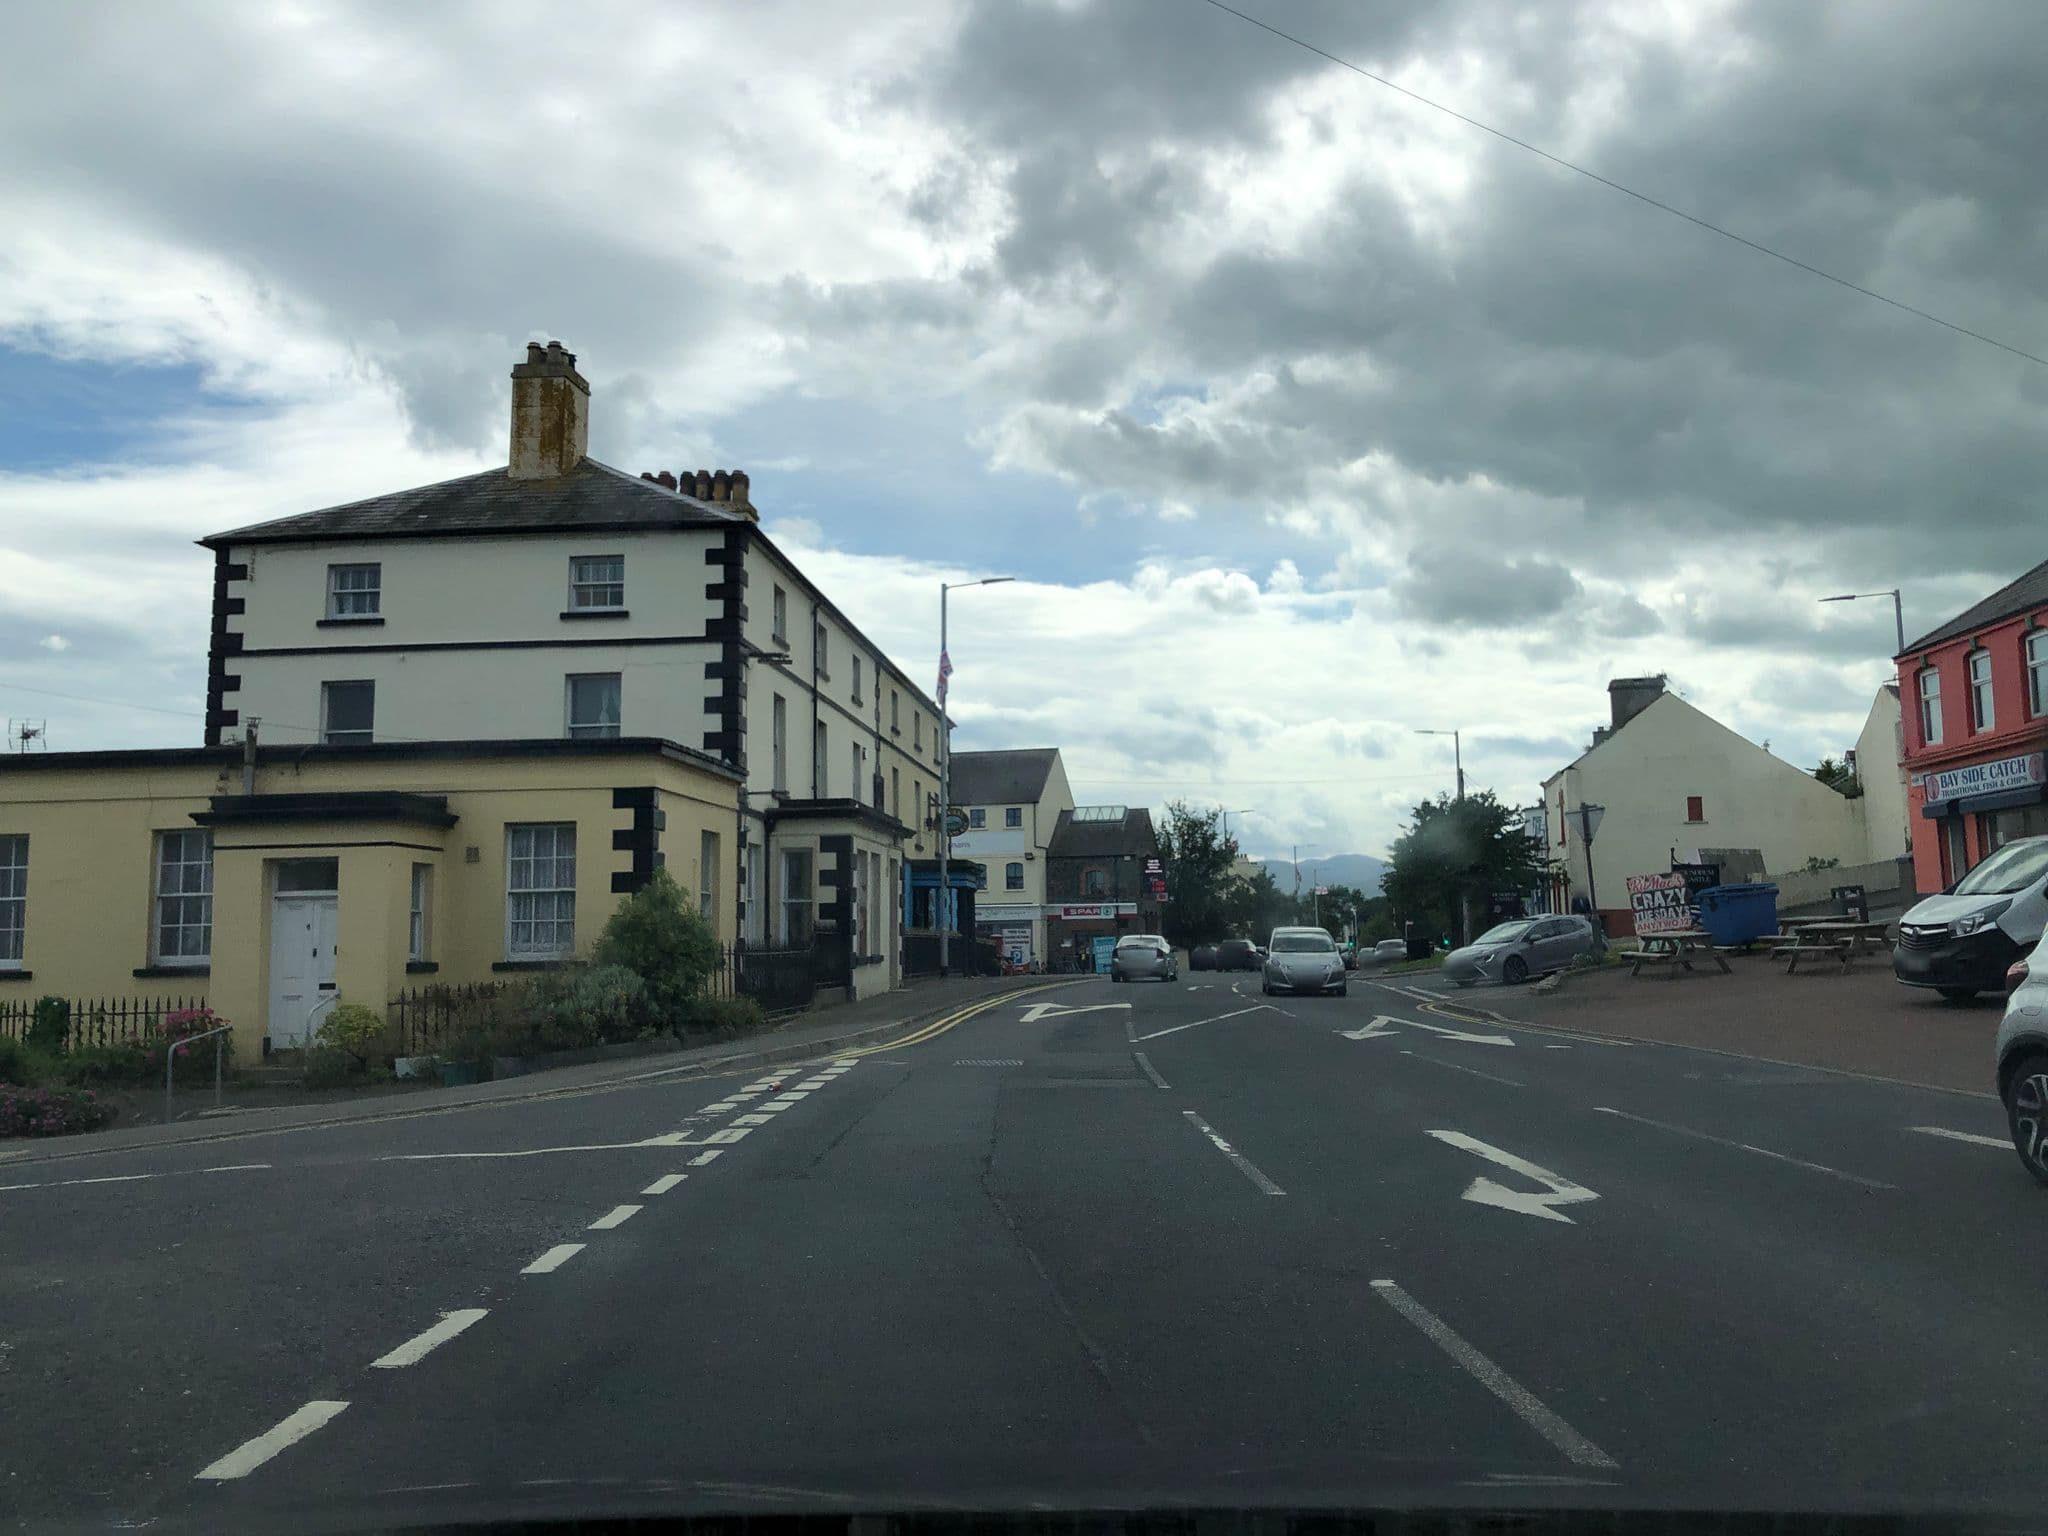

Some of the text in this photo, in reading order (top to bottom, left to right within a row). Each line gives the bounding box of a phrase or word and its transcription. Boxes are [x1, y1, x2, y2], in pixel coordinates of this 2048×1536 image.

[1940, 774, 1960, 789] BAY
[1961, 767, 1985, 784] SIDE
[1989, 759, 2026, 779] CATCH
[1941, 783, 1980, 798] TRADITIONAL
[1982, 780, 1998, 790] FISH
[2006, 776, 2028, 786] CHIPS
[1632, 888, 1686, 910] CRAZY
[1069, 907, 1100, 915] SPAR
[1635, 905, 1691, 921] TUESDAYS
[1637, 921, 1656, 931] ANY
[1656, 919, 1678, 928] TWO
